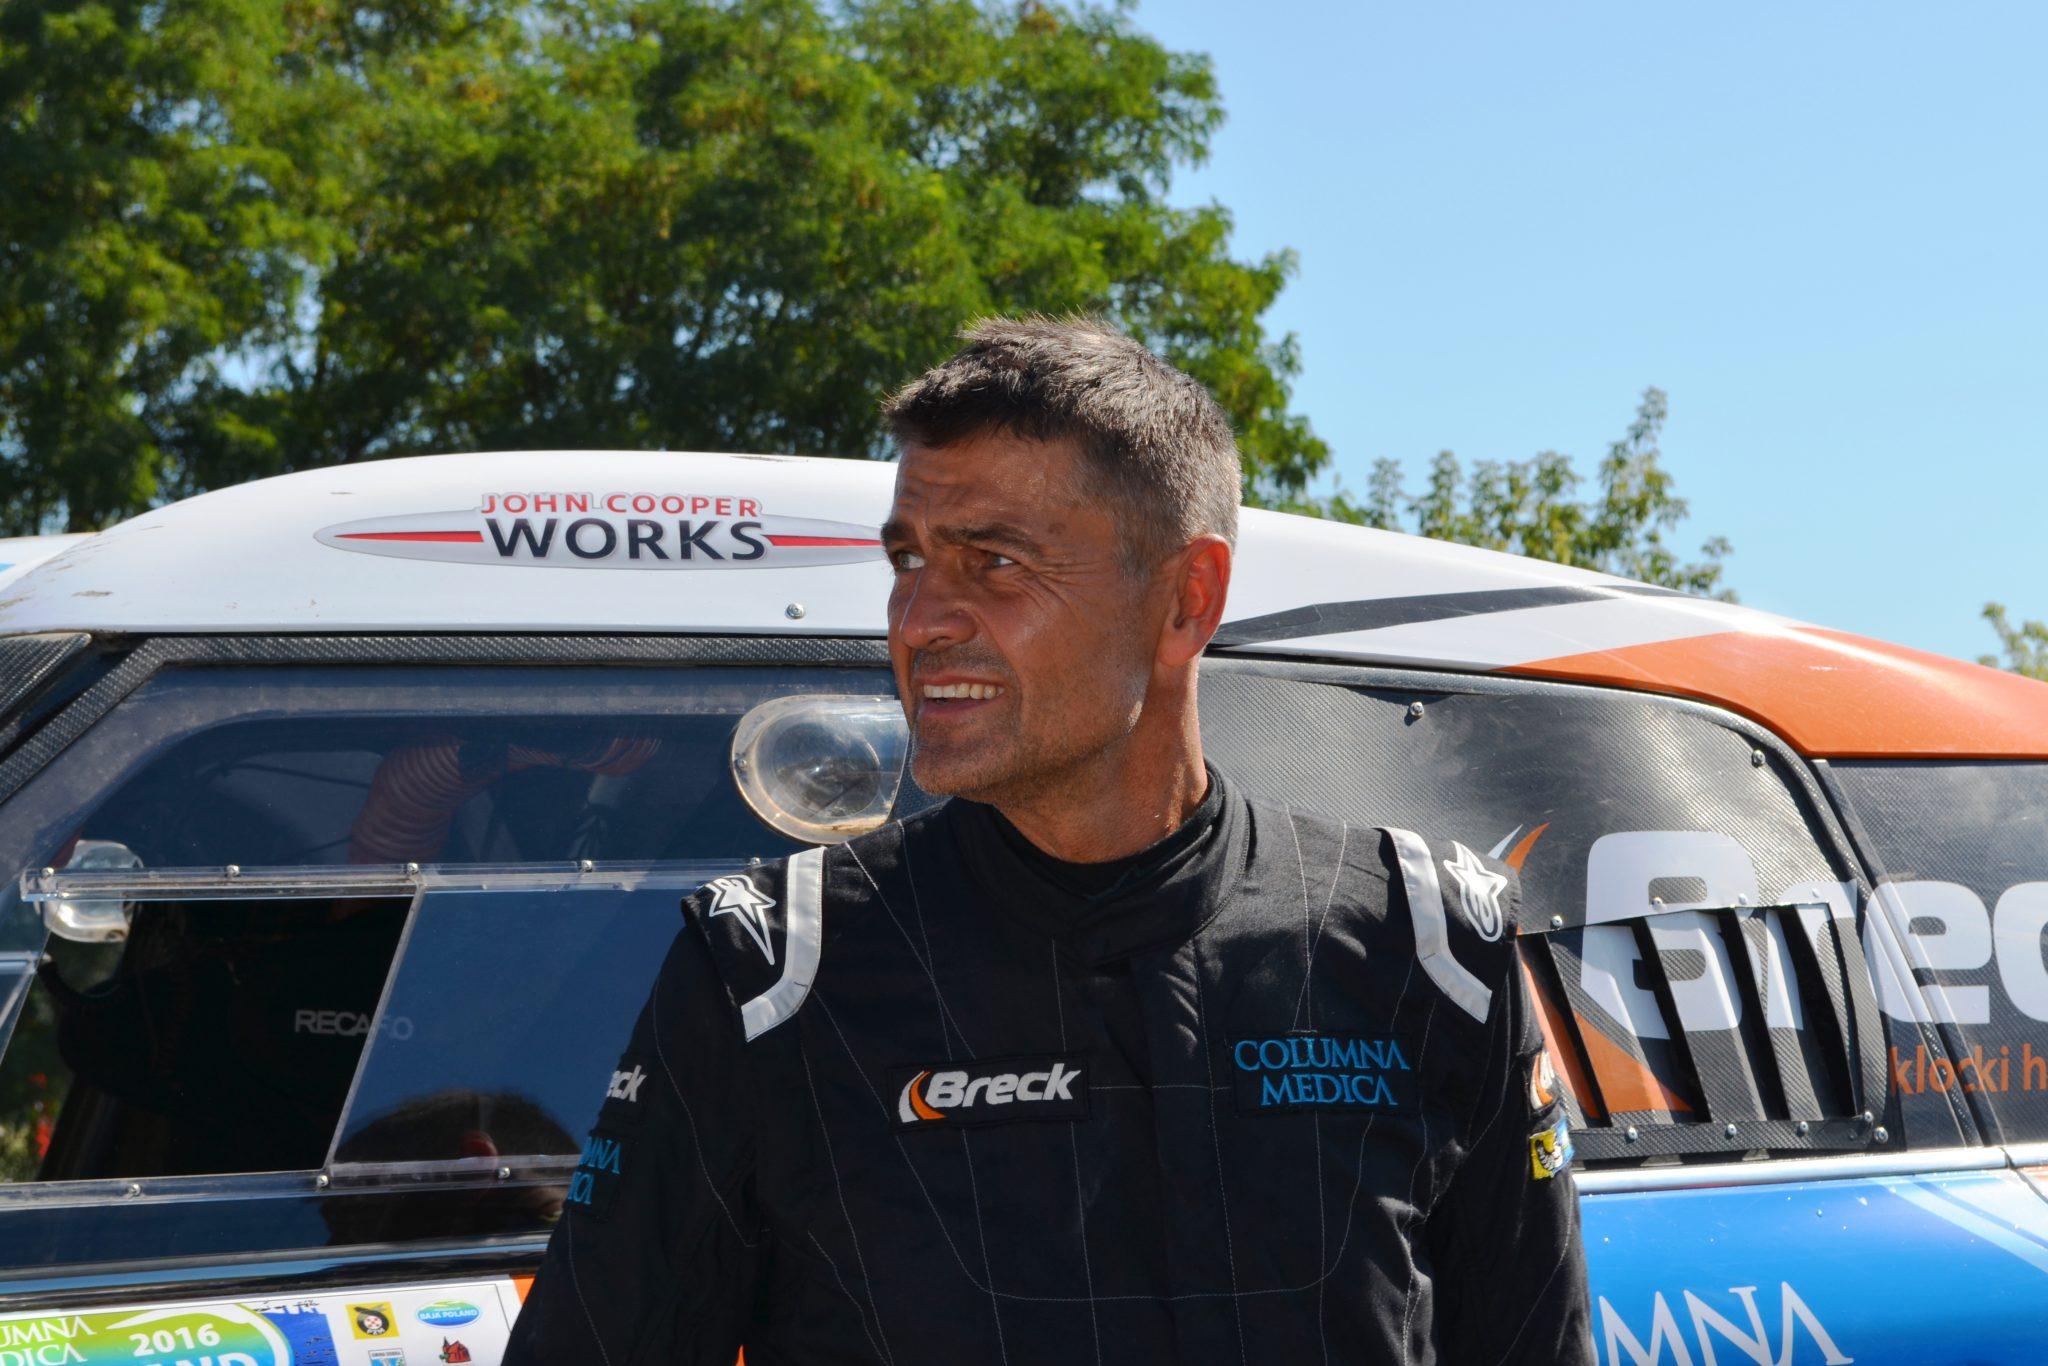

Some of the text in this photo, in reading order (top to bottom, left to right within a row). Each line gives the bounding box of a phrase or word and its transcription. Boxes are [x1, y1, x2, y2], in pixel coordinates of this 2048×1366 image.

[481, 494, 759, 517] JOHN COOPER
[484, 517, 766, 560] WORKS
[1234, 1036, 1411, 1071] COLUMNA
[606, 1064, 648, 1102] ck
[924, 1062, 1082, 1108] Breck
[1260, 1073, 1399, 1106] MEDICA
[419, 1311, 442, 1320] BAJA
[442, 1308, 478, 1318] POLAND
[1591, 1281, 1854, 1366] MNA
[129, 1323, 221, 1357] 2016
